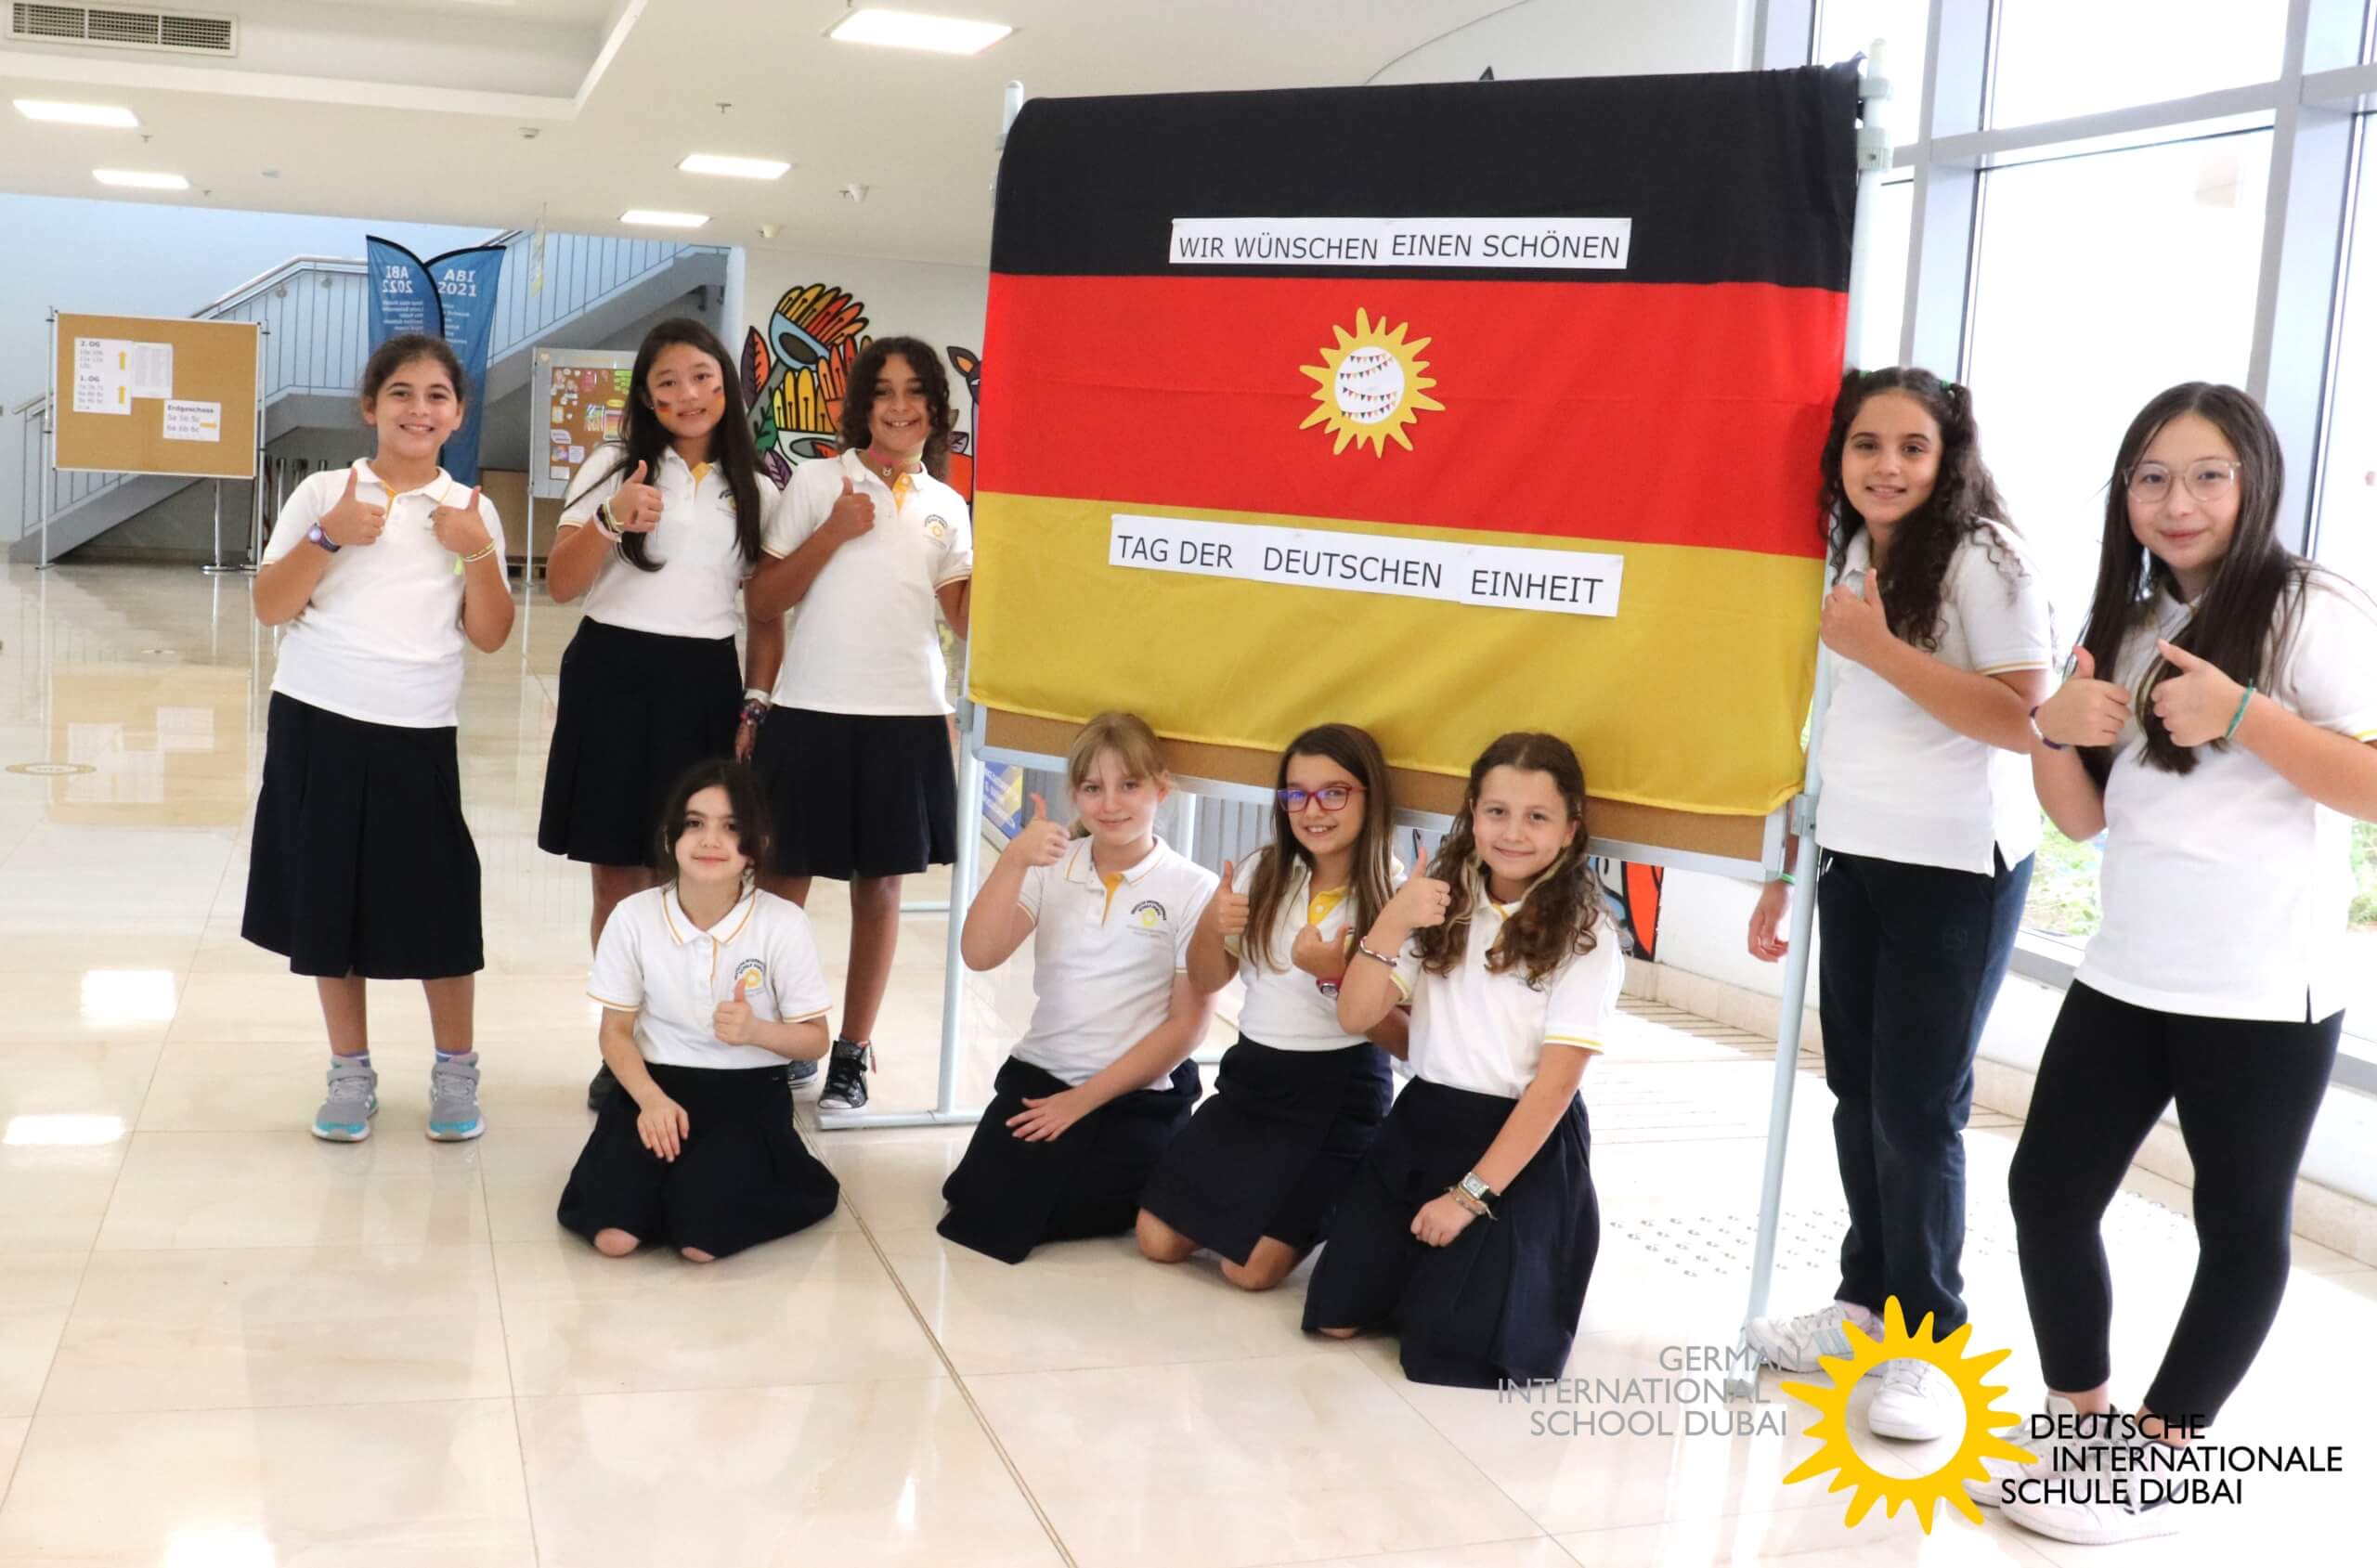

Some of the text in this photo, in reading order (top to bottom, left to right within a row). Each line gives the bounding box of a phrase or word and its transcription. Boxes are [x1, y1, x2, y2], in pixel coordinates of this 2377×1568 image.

[1179, 229, 1619, 260] WIR WÜNSCHEN EINEN SCHÖNEN
[444, 269, 476, 283] ABI
[438, 282, 477, 297] 2021
[1118, 535, 1604, 603] TAG DER DEUTSCHEN EINHEIT
